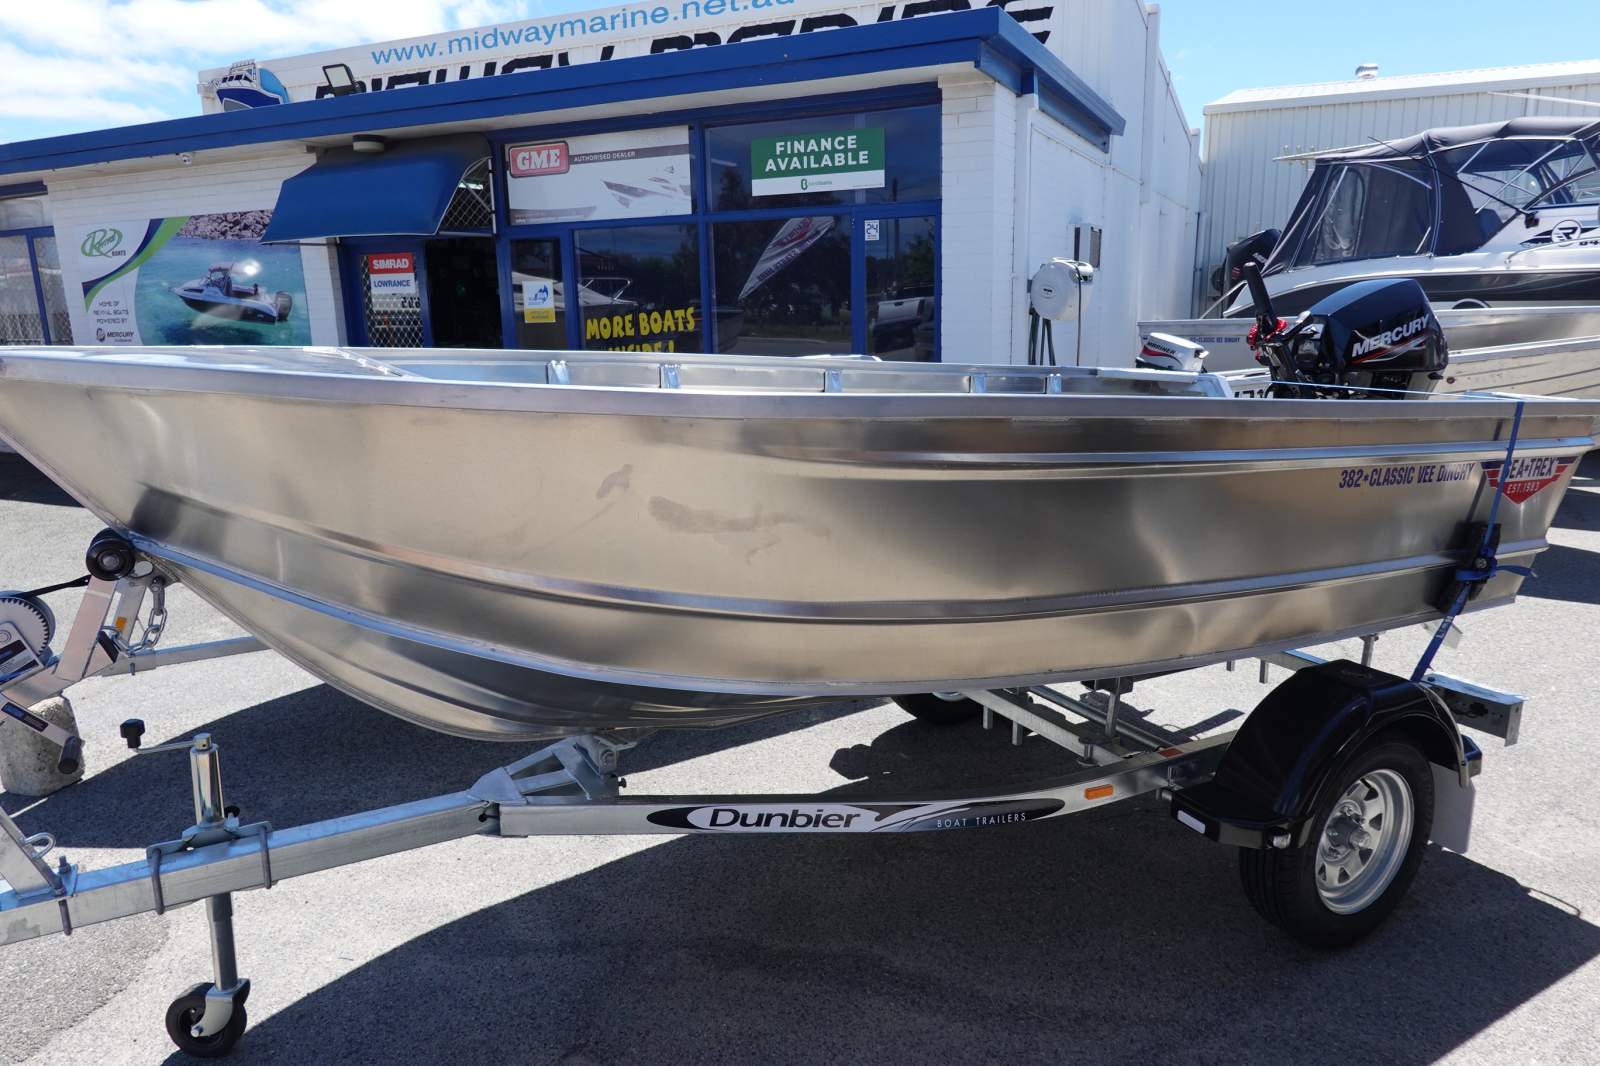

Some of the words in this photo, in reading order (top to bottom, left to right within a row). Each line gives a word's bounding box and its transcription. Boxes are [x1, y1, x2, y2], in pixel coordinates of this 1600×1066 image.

[775, 135, 857, 156] FINANCE
[516, 149, 561, 171] GME
[573, 153, 611, 162] AUTHORISED
[612, 151, 636, 160] DEALER
[765, 150, 869, 172] AVAILABLE
[372, 258, 409, 270] SIMRAD
[373, 279, 411, 288] LOWRANCE
[586, 314, 635, 340] MORE
[639, 306, 695, 337] BOATS
[1352, 313, 1430, 358] MERCURY
[1339, 468, 1364, 489] 382
[1417, 464, 1436, 484] VEE
[1436, 462, 1476, 483] DINGHY
[708, 808, 861, 828] Dunbier
[936, 818, 967, 828] BOAT
[975, 812, 1026, 827] TRAILERS
